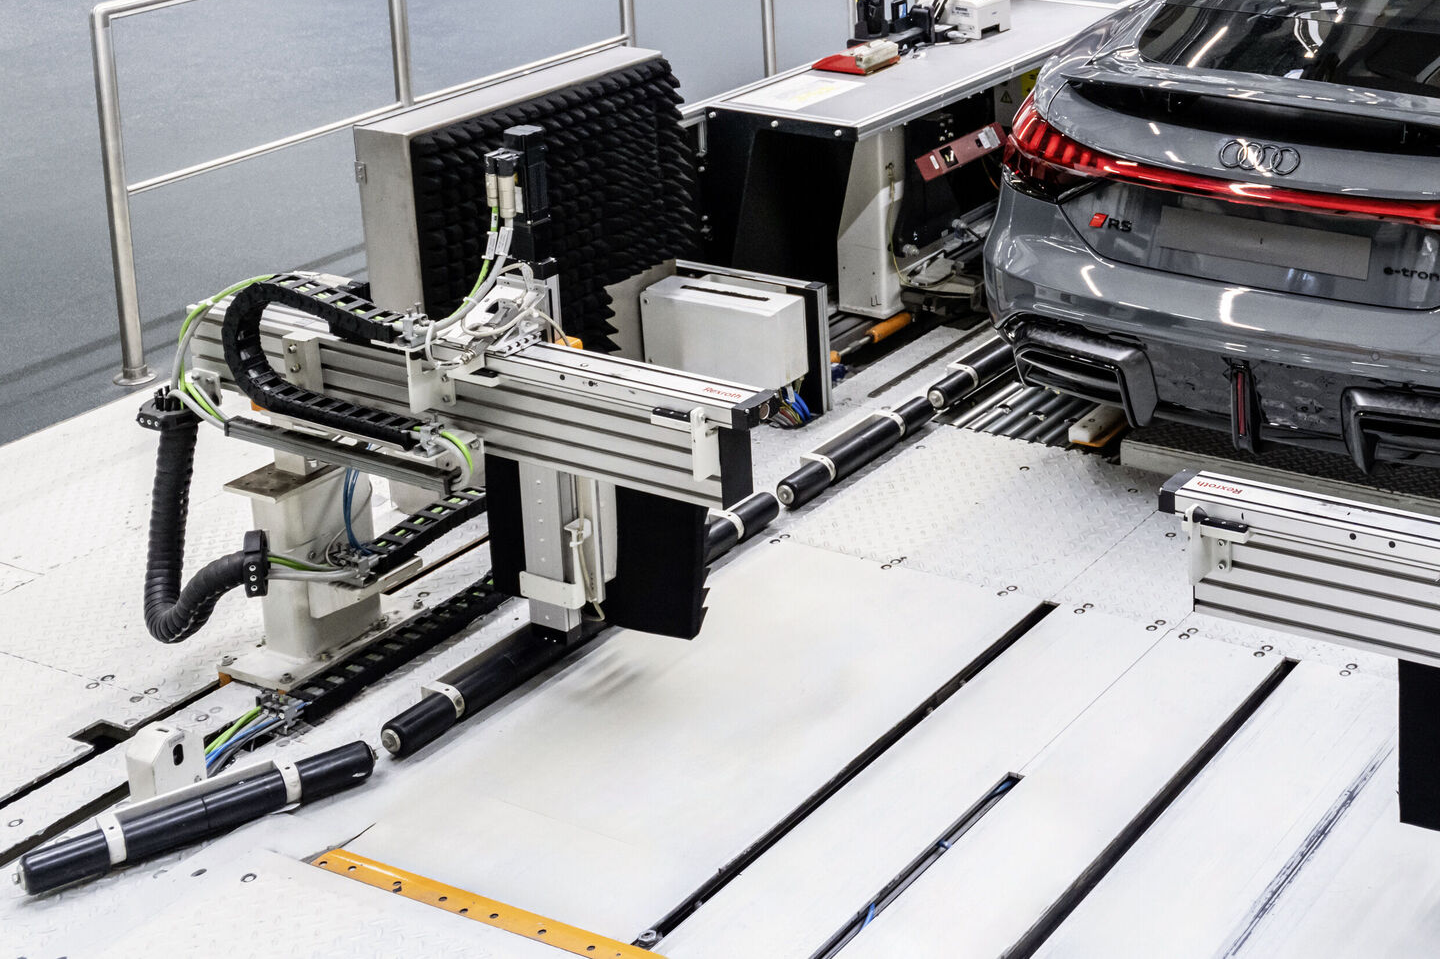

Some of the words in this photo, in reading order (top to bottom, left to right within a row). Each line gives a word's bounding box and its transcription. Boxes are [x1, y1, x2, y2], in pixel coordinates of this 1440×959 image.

[1108, 217, 1133, 232] RS
[1383, 266, 1440, 282] e-tron
[703, 386, 742, 399] Rexroth
[1197, 481, 1244, 495] Rexroth
